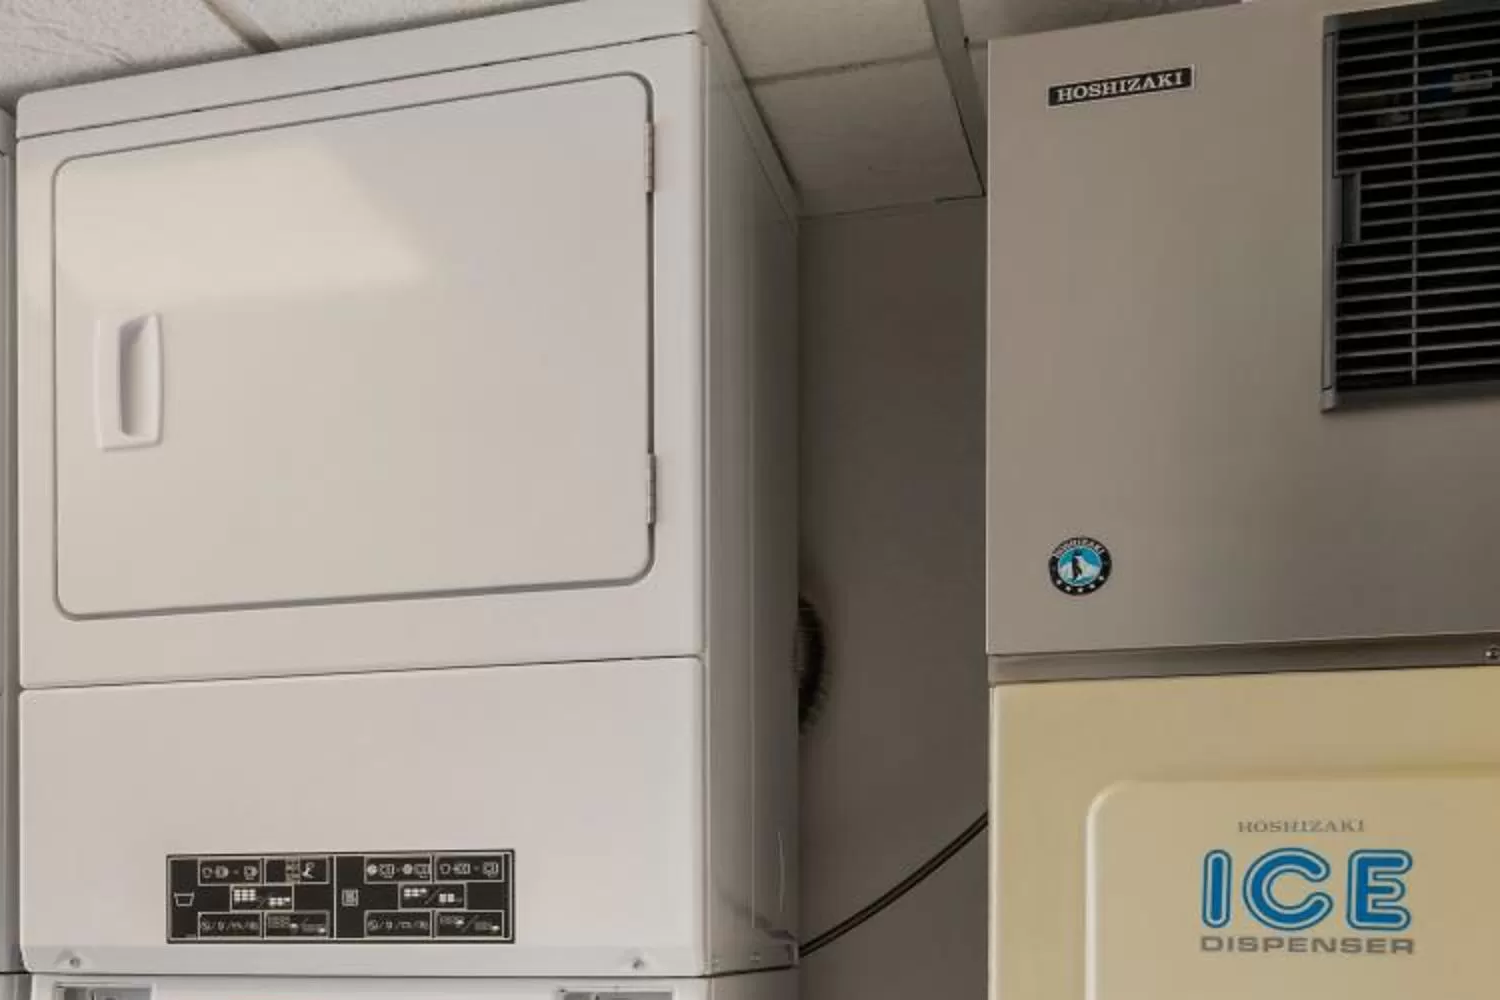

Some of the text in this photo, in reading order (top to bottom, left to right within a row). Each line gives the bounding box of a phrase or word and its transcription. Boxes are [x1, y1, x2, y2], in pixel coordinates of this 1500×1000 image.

[1057, 71, 1184, 102] HOSHIZAKI
[1238, 818, 1365, 833] HOSHIZAKI
[1201, 847, 1413, 931] ICE
[1200, 936, 1416, 954] DISPENSER
